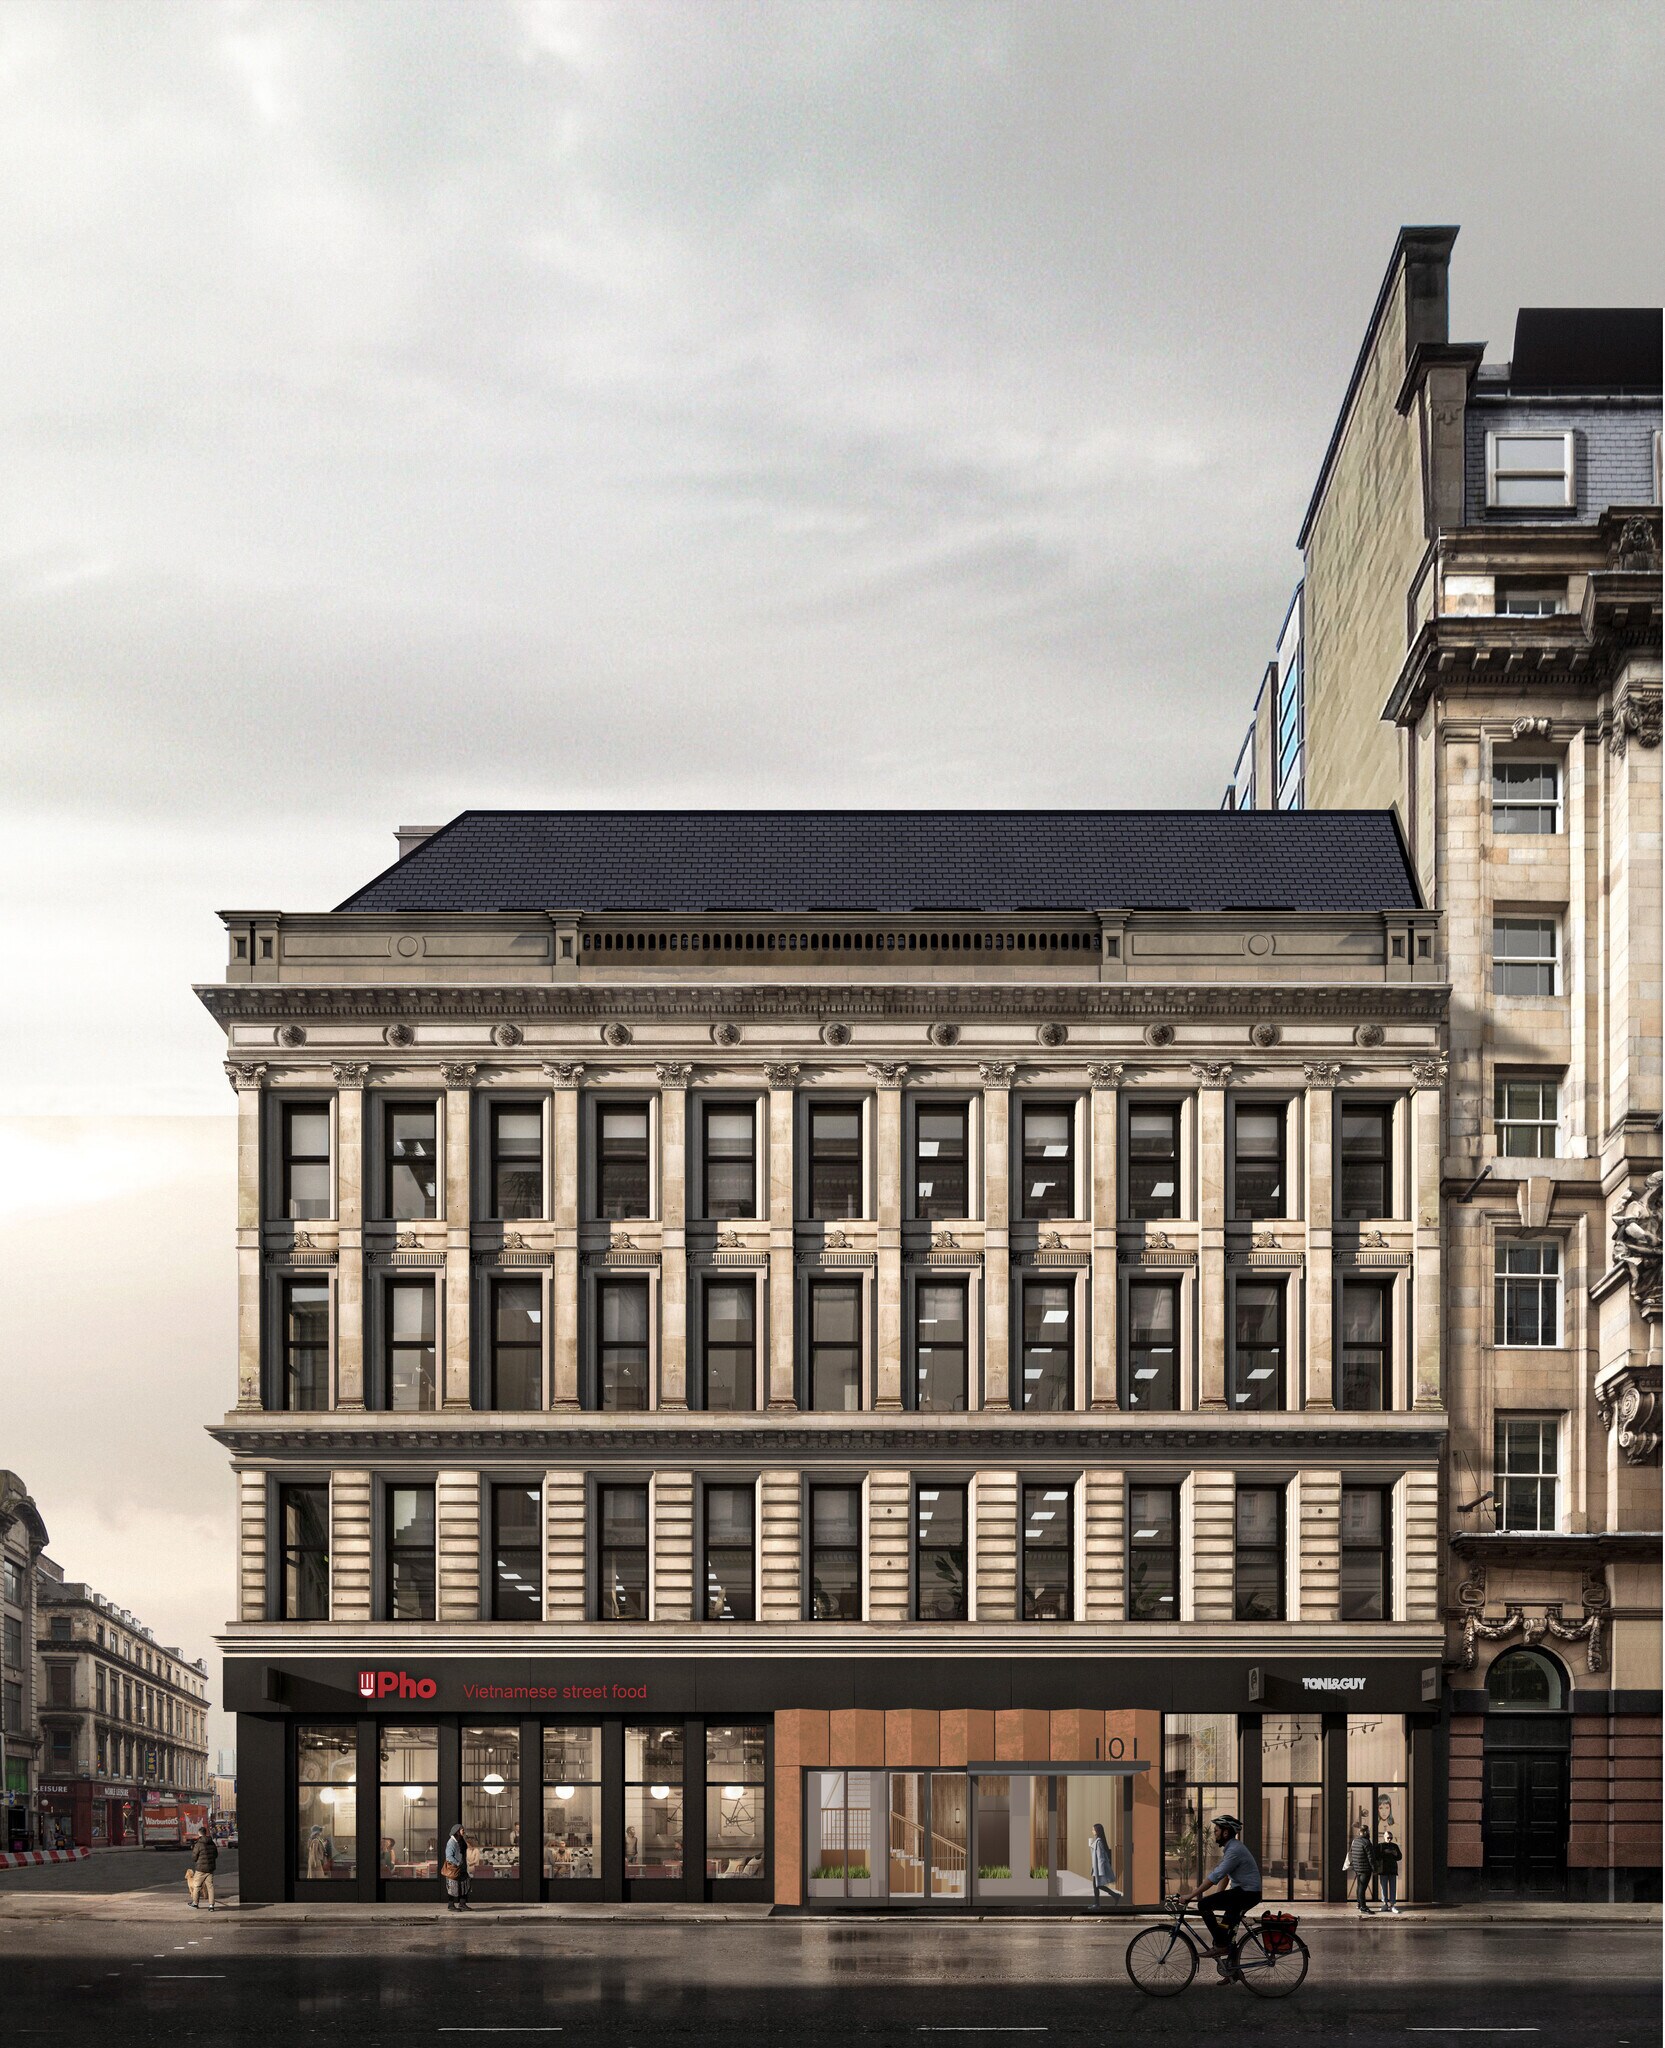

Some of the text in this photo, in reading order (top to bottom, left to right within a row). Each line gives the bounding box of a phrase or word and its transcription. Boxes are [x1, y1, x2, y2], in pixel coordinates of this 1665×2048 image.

[378, 1671, 437, 1698] Pho
[1302, 1678, 1366, 1690] TONI&GUY
[463, 1684, 647, 1698] Vietnamese street food
[38, 1785, 68, 1793] EISURE
[145, 1816, 179, 1825] Warburtons
